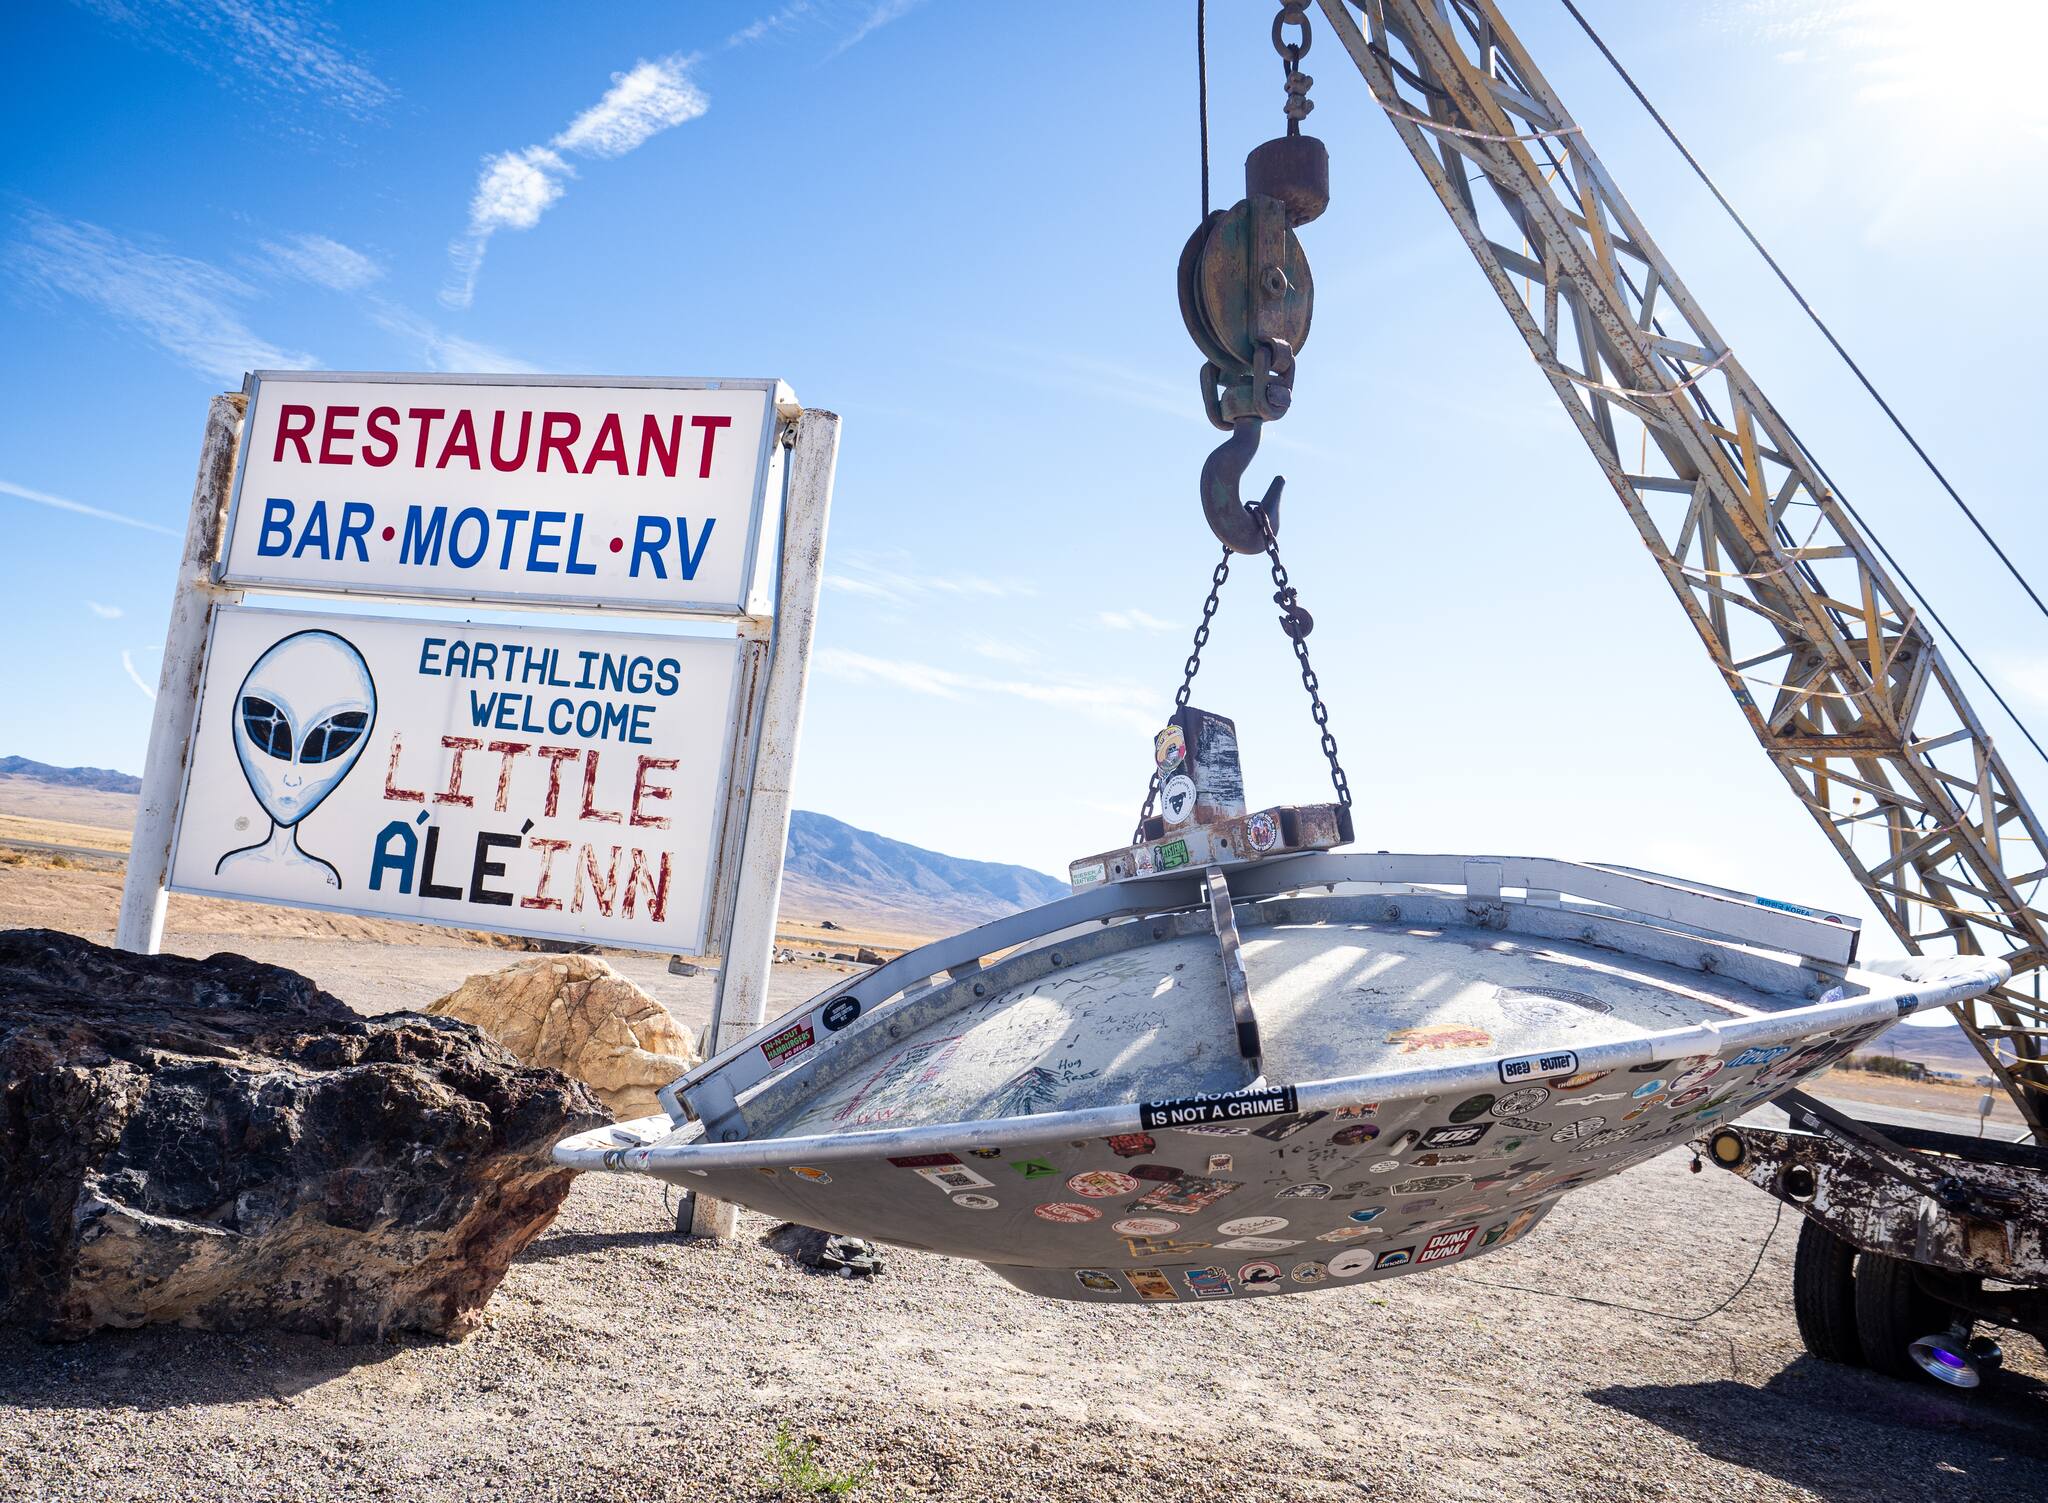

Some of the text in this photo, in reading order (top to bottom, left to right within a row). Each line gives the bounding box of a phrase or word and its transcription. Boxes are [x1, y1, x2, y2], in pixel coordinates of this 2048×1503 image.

[273, 404, 732, 479] RESTAURANT
[256, 497, 717, 581] BAR MOTEL RV
[418, 637, 681, 697] EARTHLINGS
[470, 689, 657, 745] WELCOME
[382, 731, 681, 830] LITTLE
[764, 1028, 798, 1052] IN-N-OUT
[767, 1031, 810, 1059] HAMBURGERS
[793, 1042, 808, 1055] DELAY
[1151, 1098, 1285, 1126] IS NOT A CRIME
[1430, 1128, 1481, 1143] 108
[1420, 1242, 1465, 1262] DUNK
[1428, 1229, 1474, 1249] DUNK
